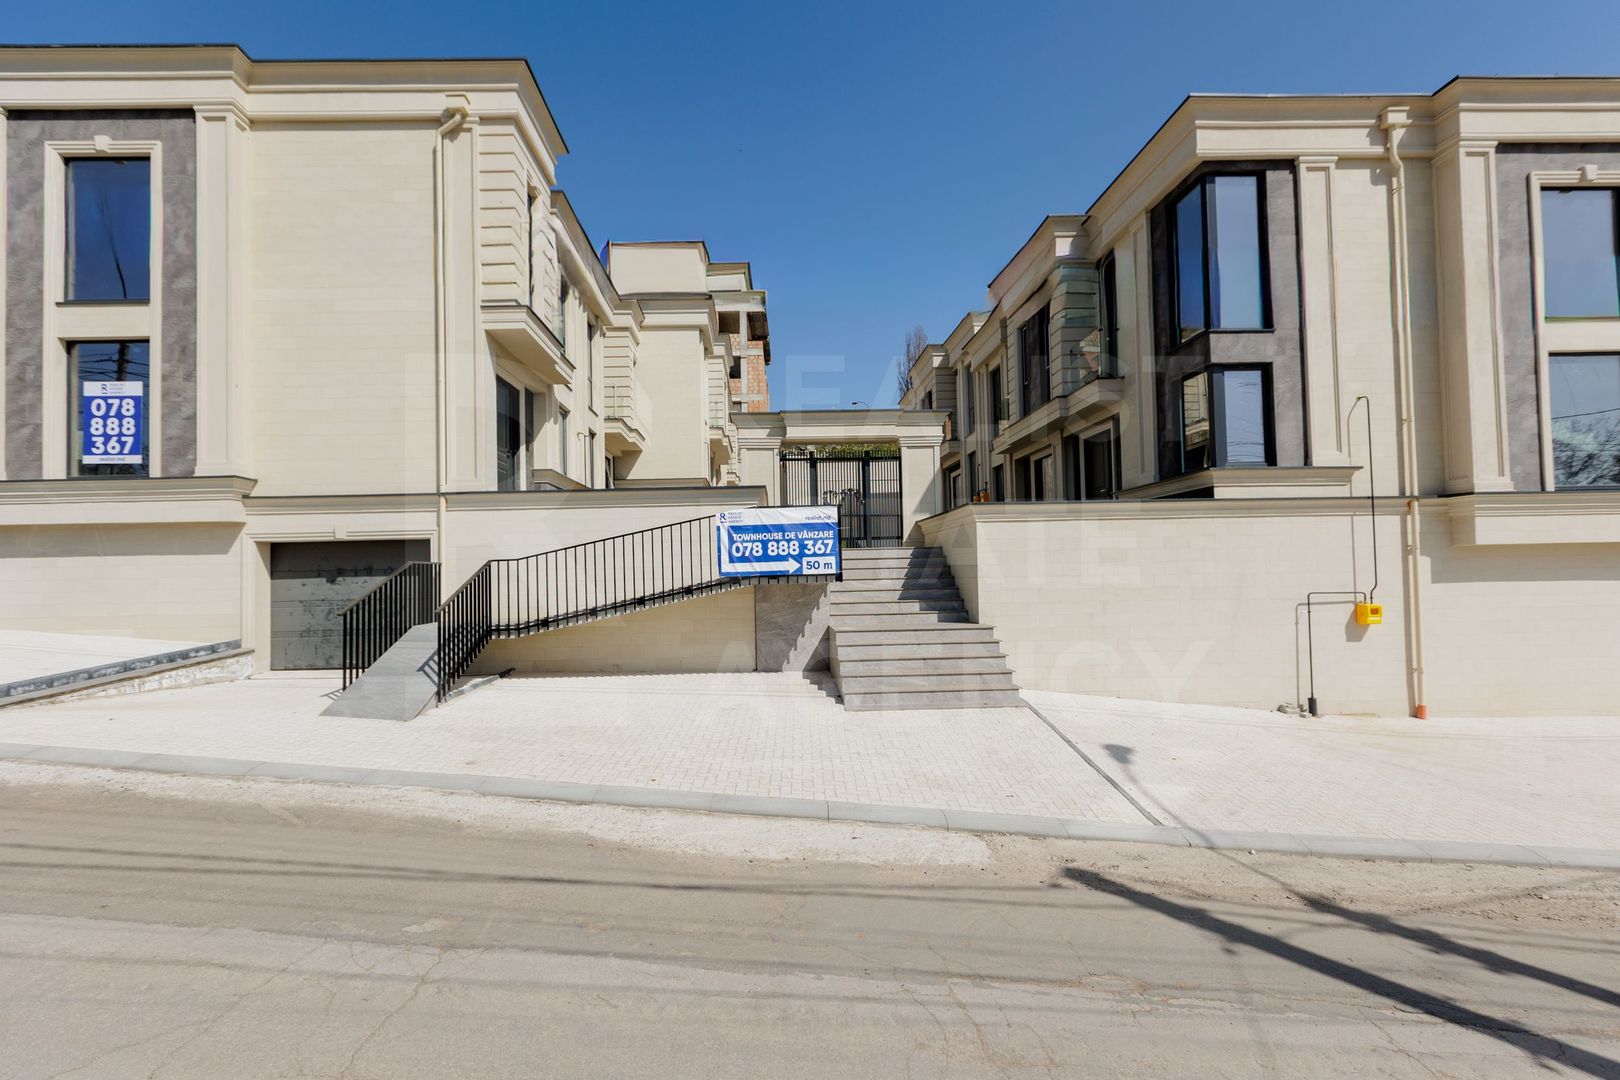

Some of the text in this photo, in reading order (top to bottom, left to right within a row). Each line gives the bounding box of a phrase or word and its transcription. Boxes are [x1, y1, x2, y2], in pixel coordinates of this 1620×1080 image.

[91, 398, 135, 416] 078
[90, 417, 135, 435] 888
[91, 437, 134, 454] 367
[732, 530, 834, 541] TOWNHOUSE DE VÂNZARE
[732, 539, 834, 557] 078 888 367
[806, 561, 820, 570] 50
